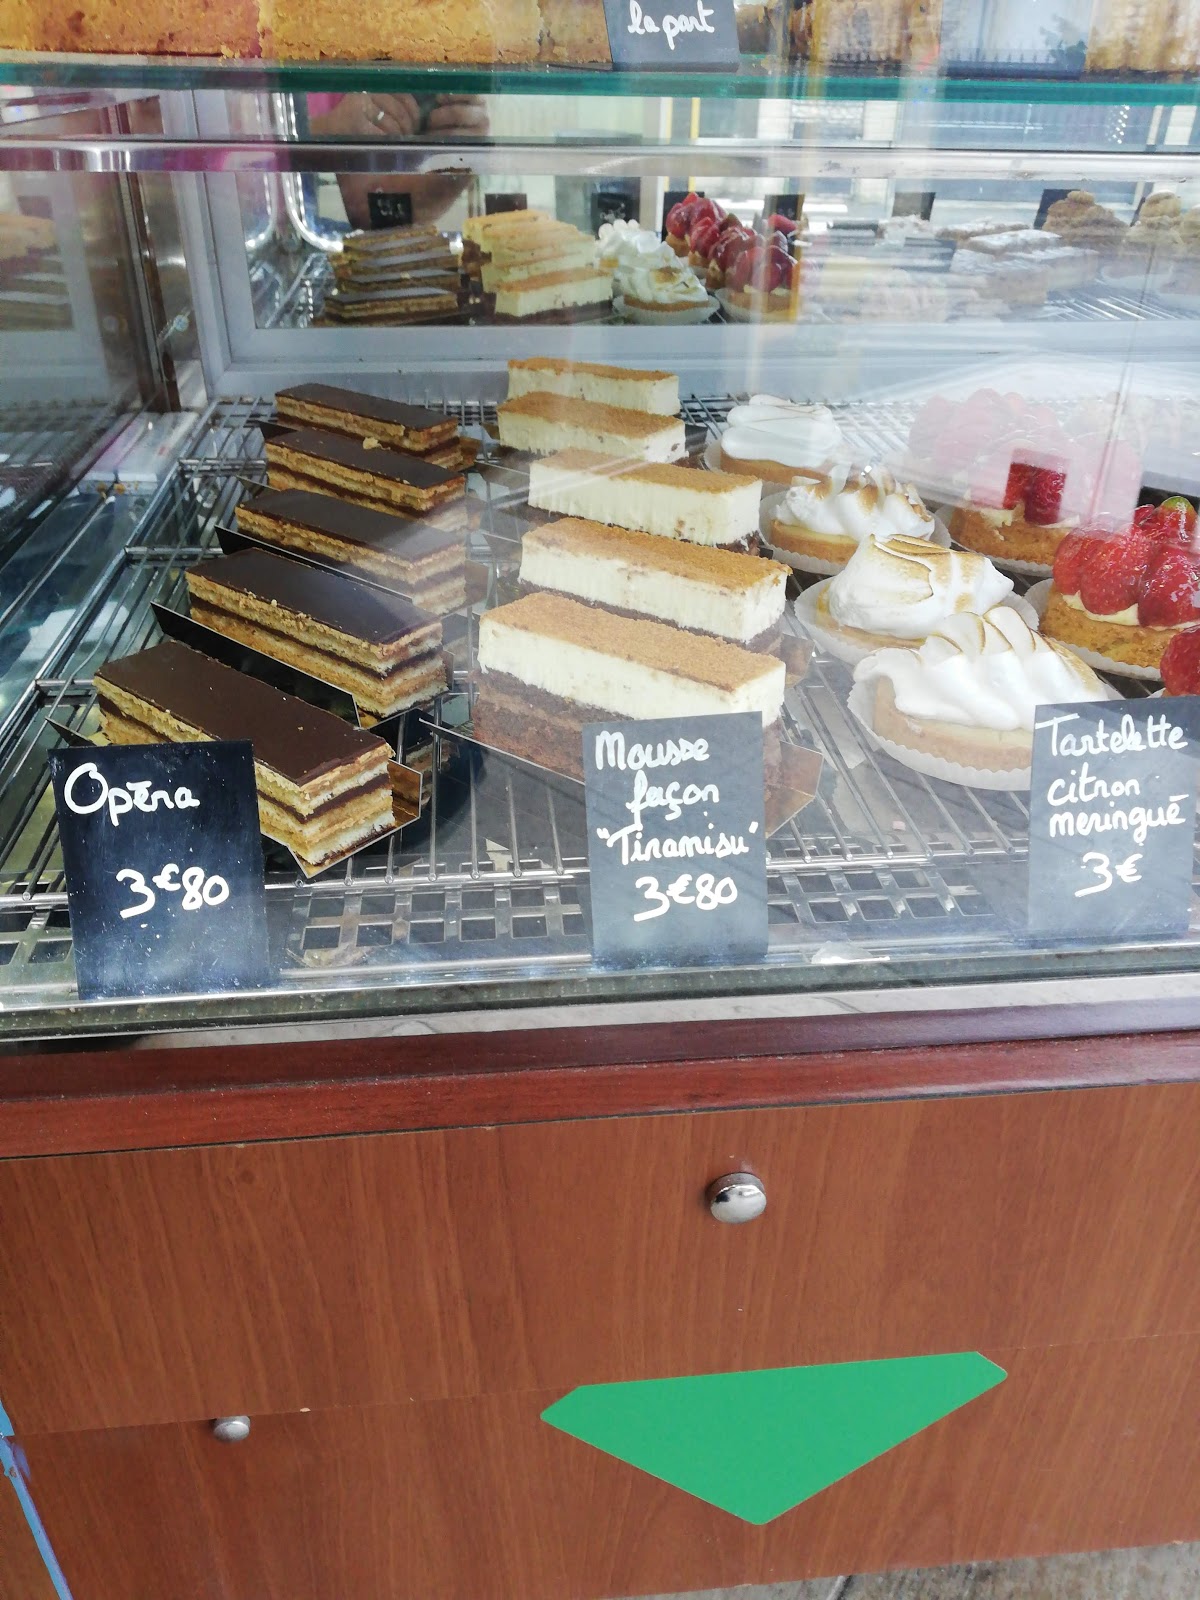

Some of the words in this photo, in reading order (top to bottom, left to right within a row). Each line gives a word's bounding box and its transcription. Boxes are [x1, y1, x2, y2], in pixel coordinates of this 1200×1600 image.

[626, 0, 661, 35] la
[662, 0, 715, 50] part
[595, 730, 710, 771] Mousse
[1035, 712, 1189, 757] Tartelette
[63, 761, 201, 827] Opéra
[626, 769, 720, 824] façon
[1047, 761, 1141, 807] citron
[1049, 794, 1190, 844] meringué
[115, 862, 230, 919] 3€80
[633, 872, 738, 922] 3€80
